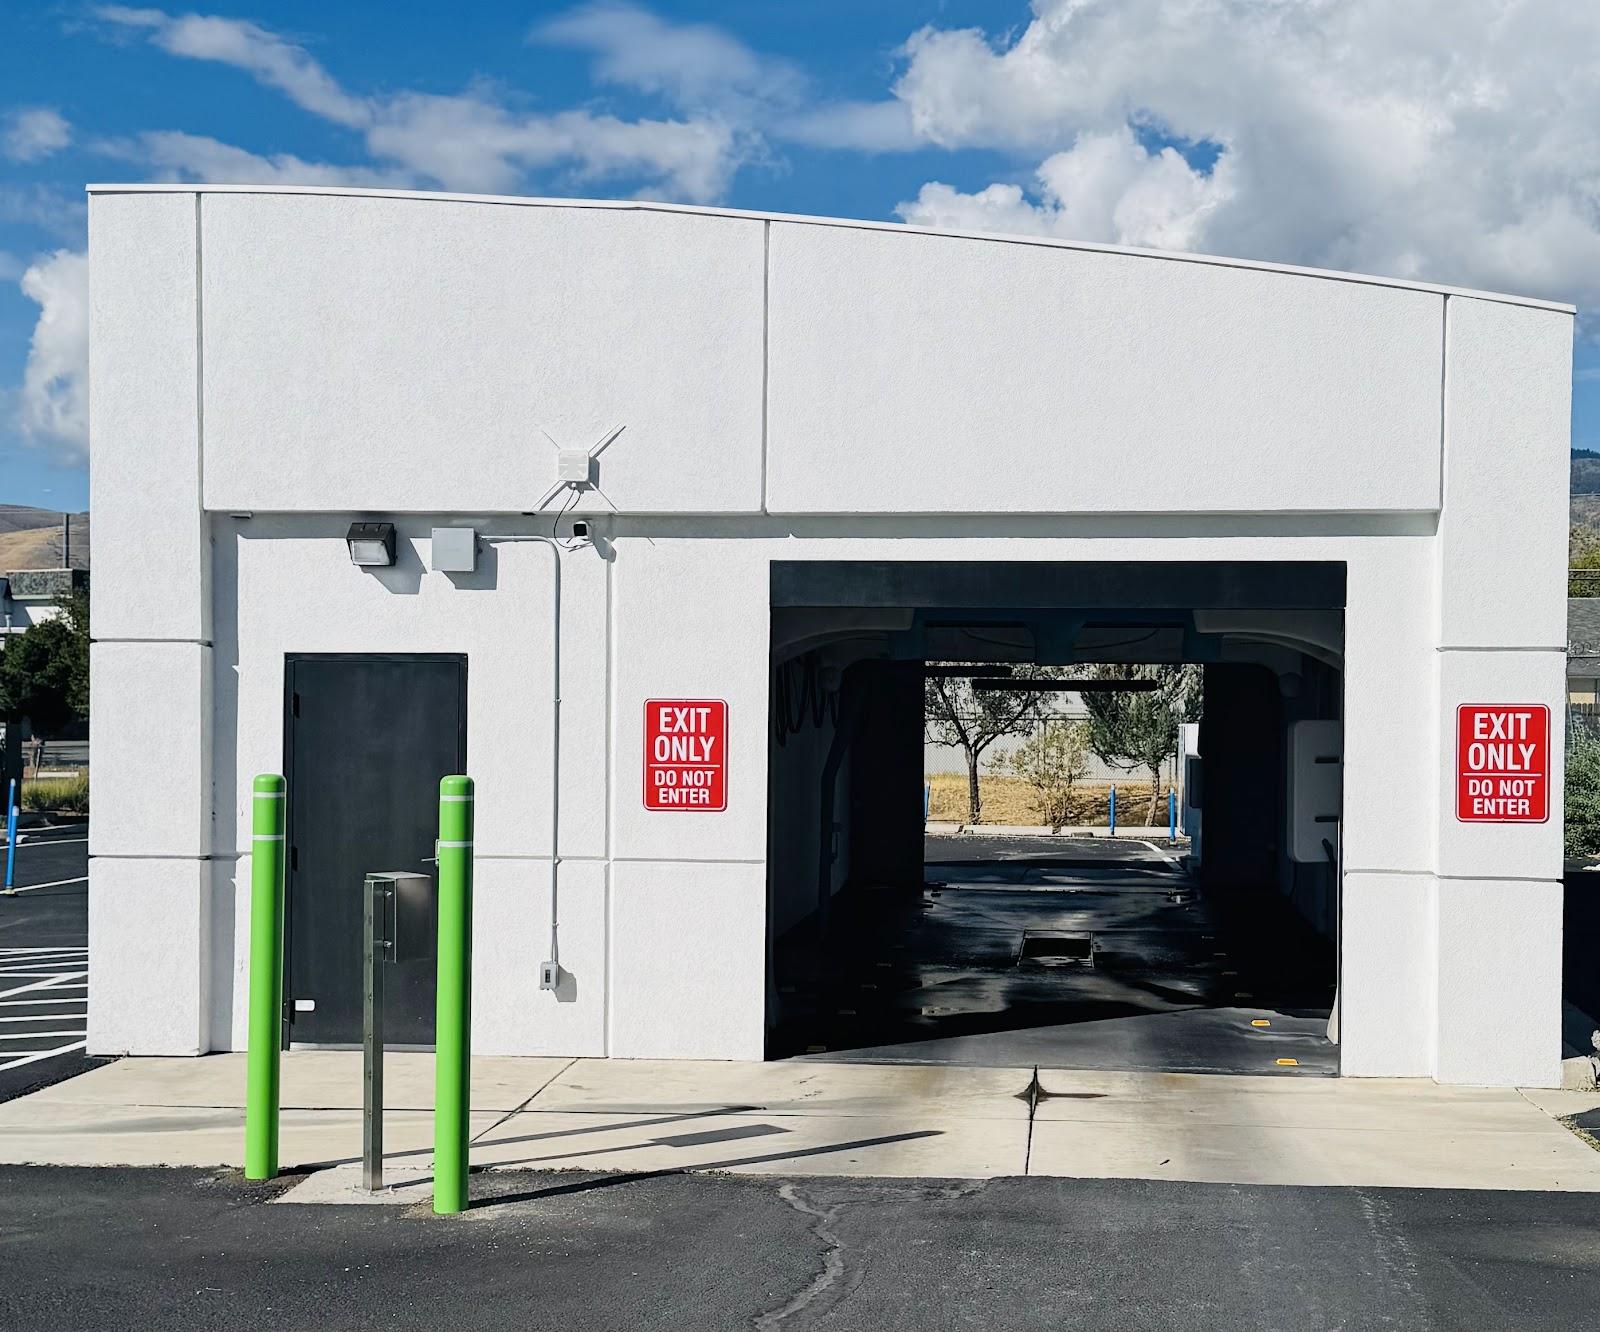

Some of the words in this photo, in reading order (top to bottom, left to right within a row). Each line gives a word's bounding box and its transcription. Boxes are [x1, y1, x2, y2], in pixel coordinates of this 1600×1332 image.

[660, 707, 711, 733] EXIT
[1474, 712, 1531, 740] EXIT
[655, 735, 715, 762] ONLY
[1468, 742, 1536, 770] ONLY
[655, 770, 677, 786] DO
[682, 770, 715, 787] NOT
[1468, 779, 1493, 797] DO
[1499, 779, 1536, 797] NOT
[659, 788, 710, 804] ENTER
[1473, 798, 1530, 815] ENTER
